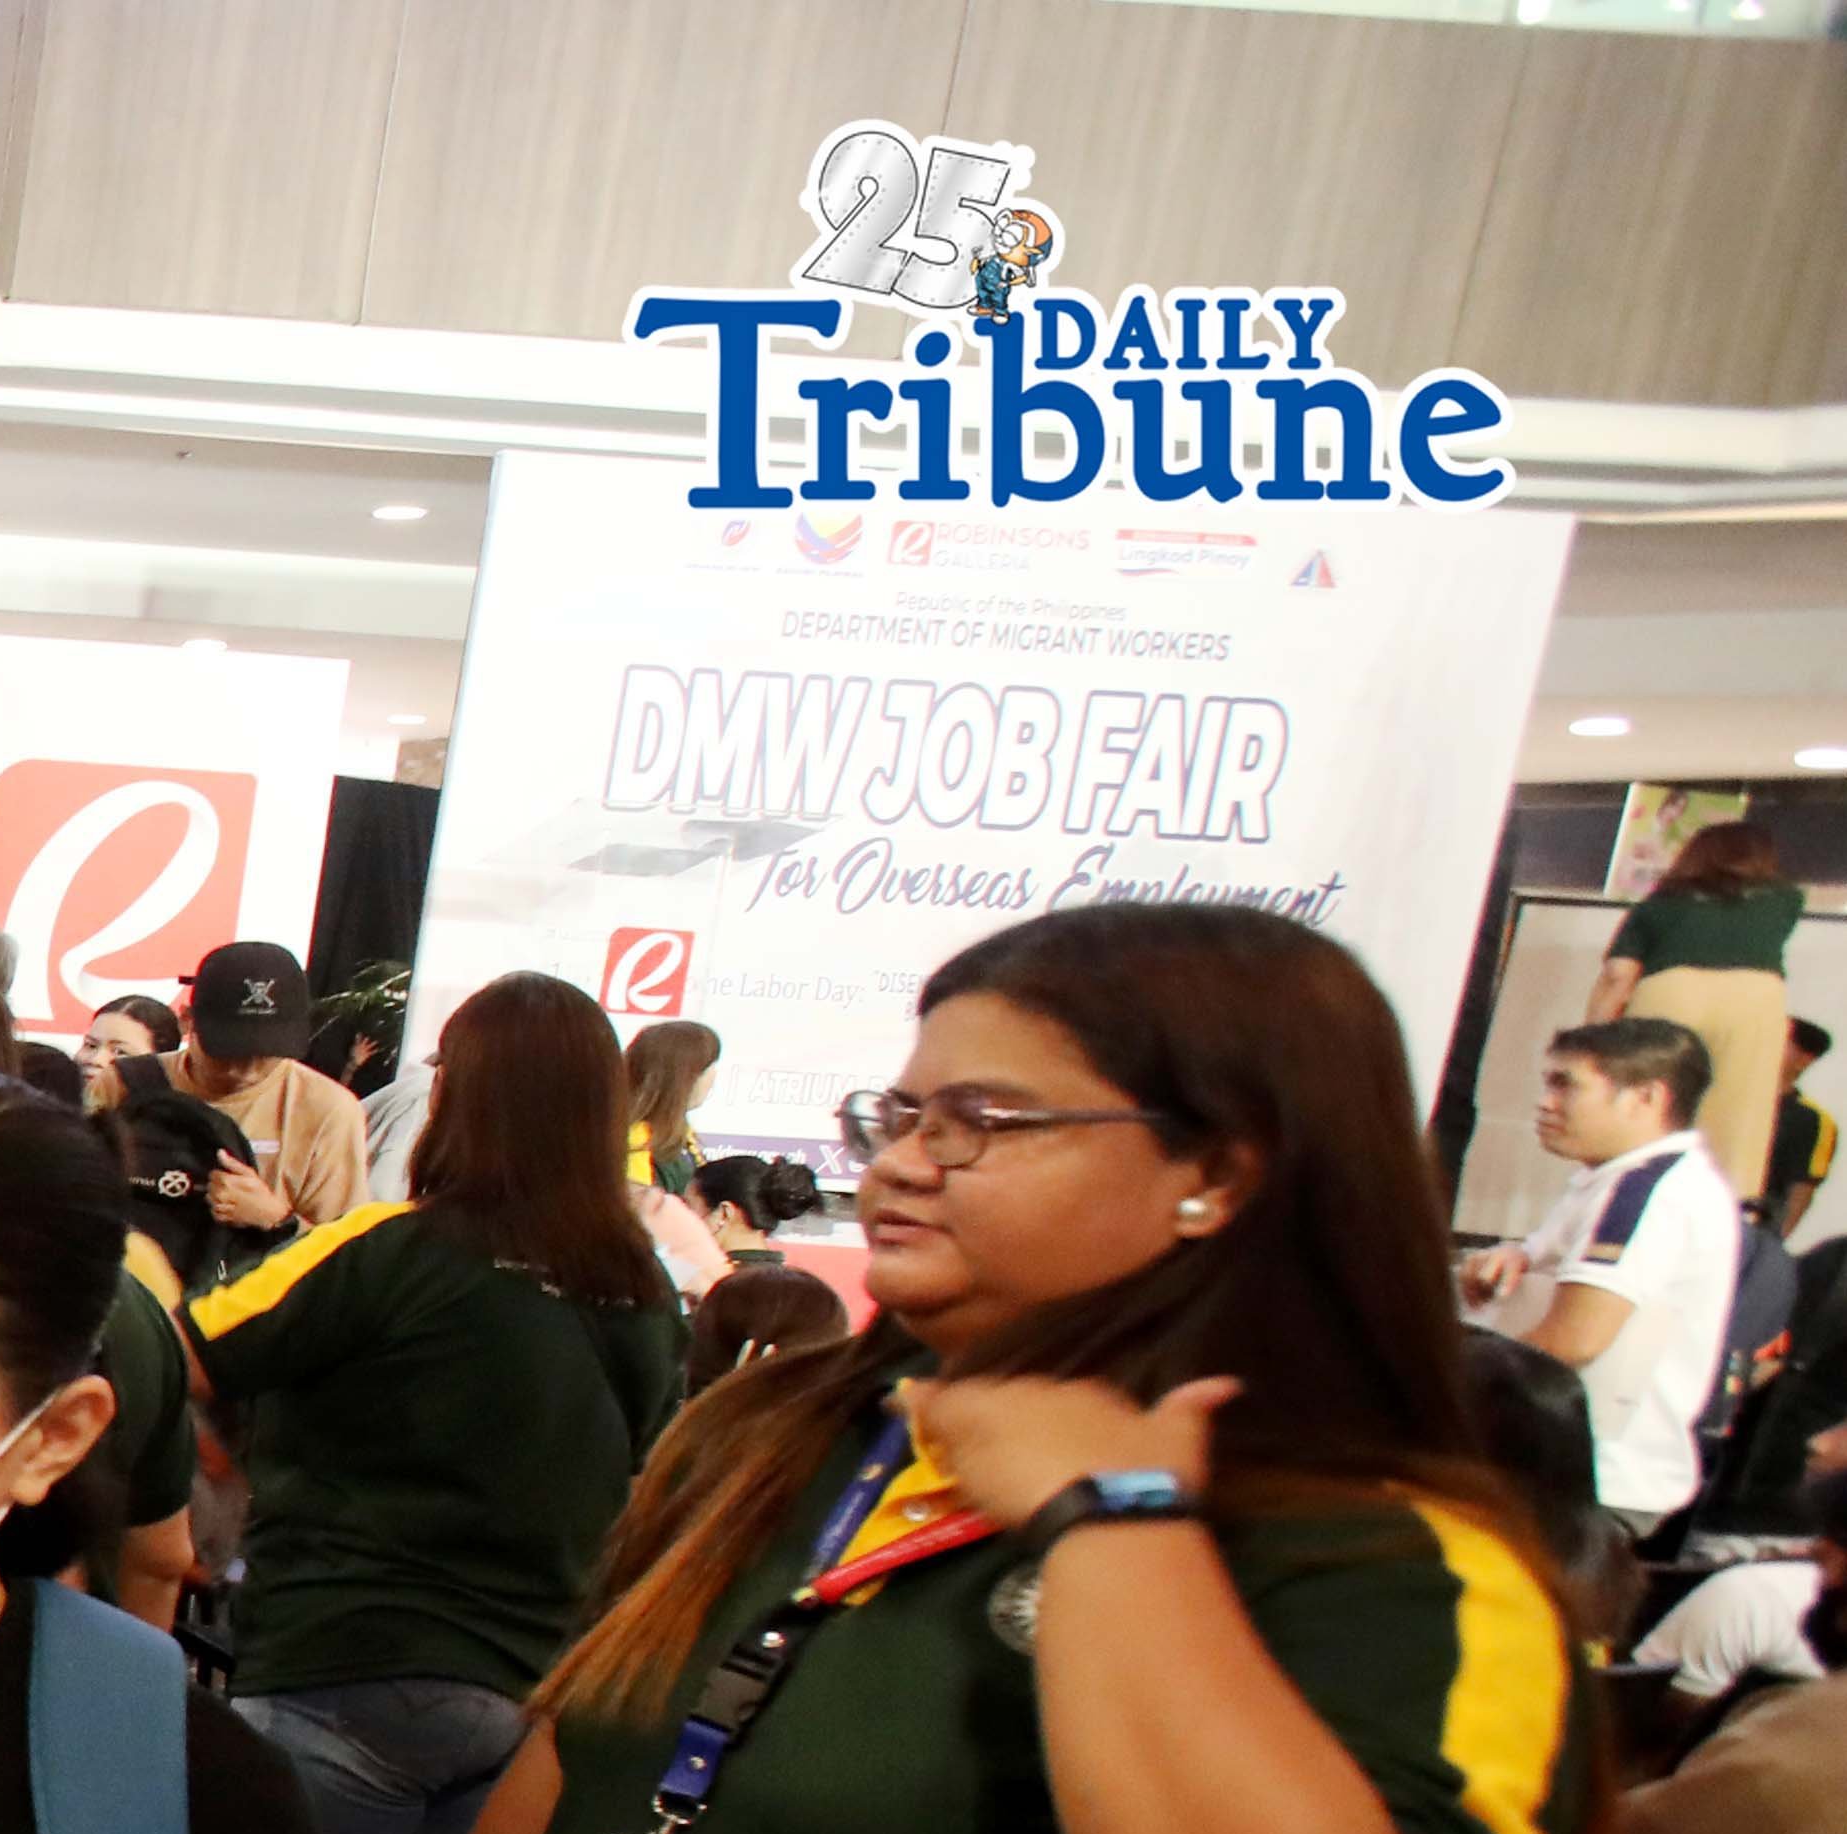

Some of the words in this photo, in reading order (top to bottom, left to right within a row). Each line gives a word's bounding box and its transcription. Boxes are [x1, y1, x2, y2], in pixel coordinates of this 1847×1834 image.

[936, 523, 1090, 551] ROBINSONS
[1118, 545, 1193, 569] Lingkod
[1198, 549, 1250, 571] Pinoy
[896, 591, 970, 613] Republic
[782, 611, 945, 647] DEPARTMENT
[951, 622, 983, 648] OF
[988, 623, 1101, 656] MIGRANT
[1107, 630, 1231, 662] WORKERS
[602, 664, 871, 819] DMW
[863, 678, 1060, 832] JOB
[1061, 688, 1290, 844] FAIR
[836, 836, 1037, 917] Overseas
[738, 972, 811, 1002] Labor
